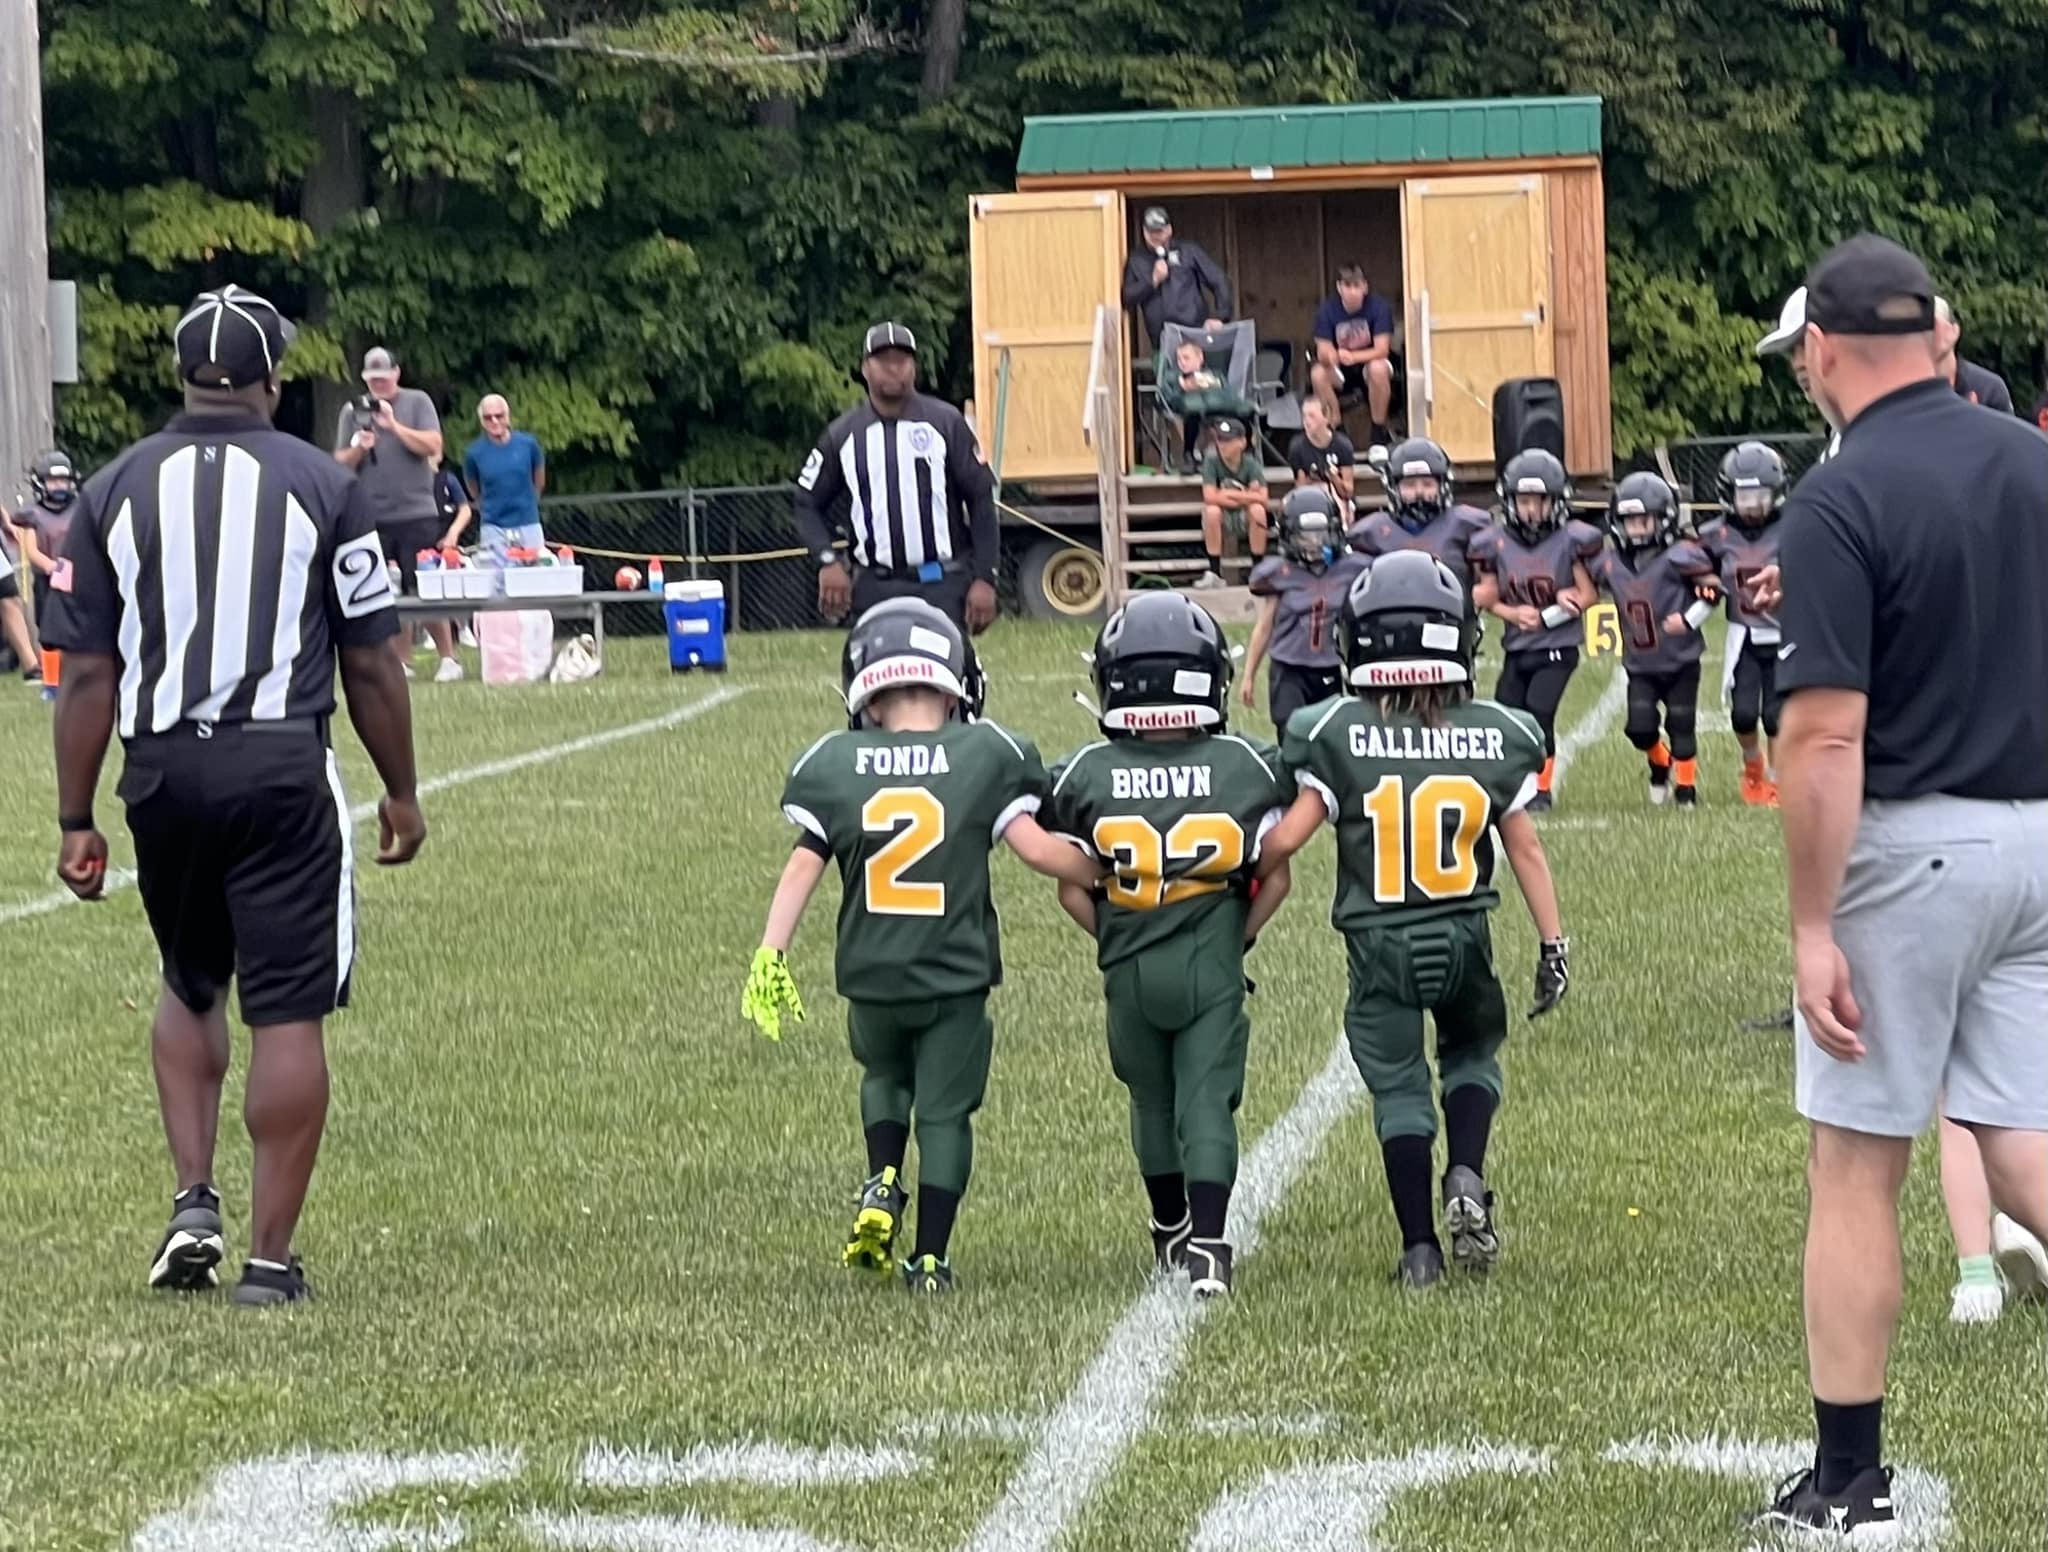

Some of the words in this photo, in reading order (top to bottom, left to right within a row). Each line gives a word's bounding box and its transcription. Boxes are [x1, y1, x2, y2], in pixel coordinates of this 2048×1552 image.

[339, 549, 390, 605] 2
[862, 662, 934, 690] Riddell
[1369, 667, 1444, 684] Riddell
[1123, 709, 1197, 728] Riddell
[855, 744, 950, 776] FONDA
[1348, 723, 1505, 761] GALLINGER
[1111, 765, 1212, 799] BROWN
[861, 786, 945, 917] 2
[1363, 774, 1492, 904] 10
[1093, 812, 1245, 913] 32
